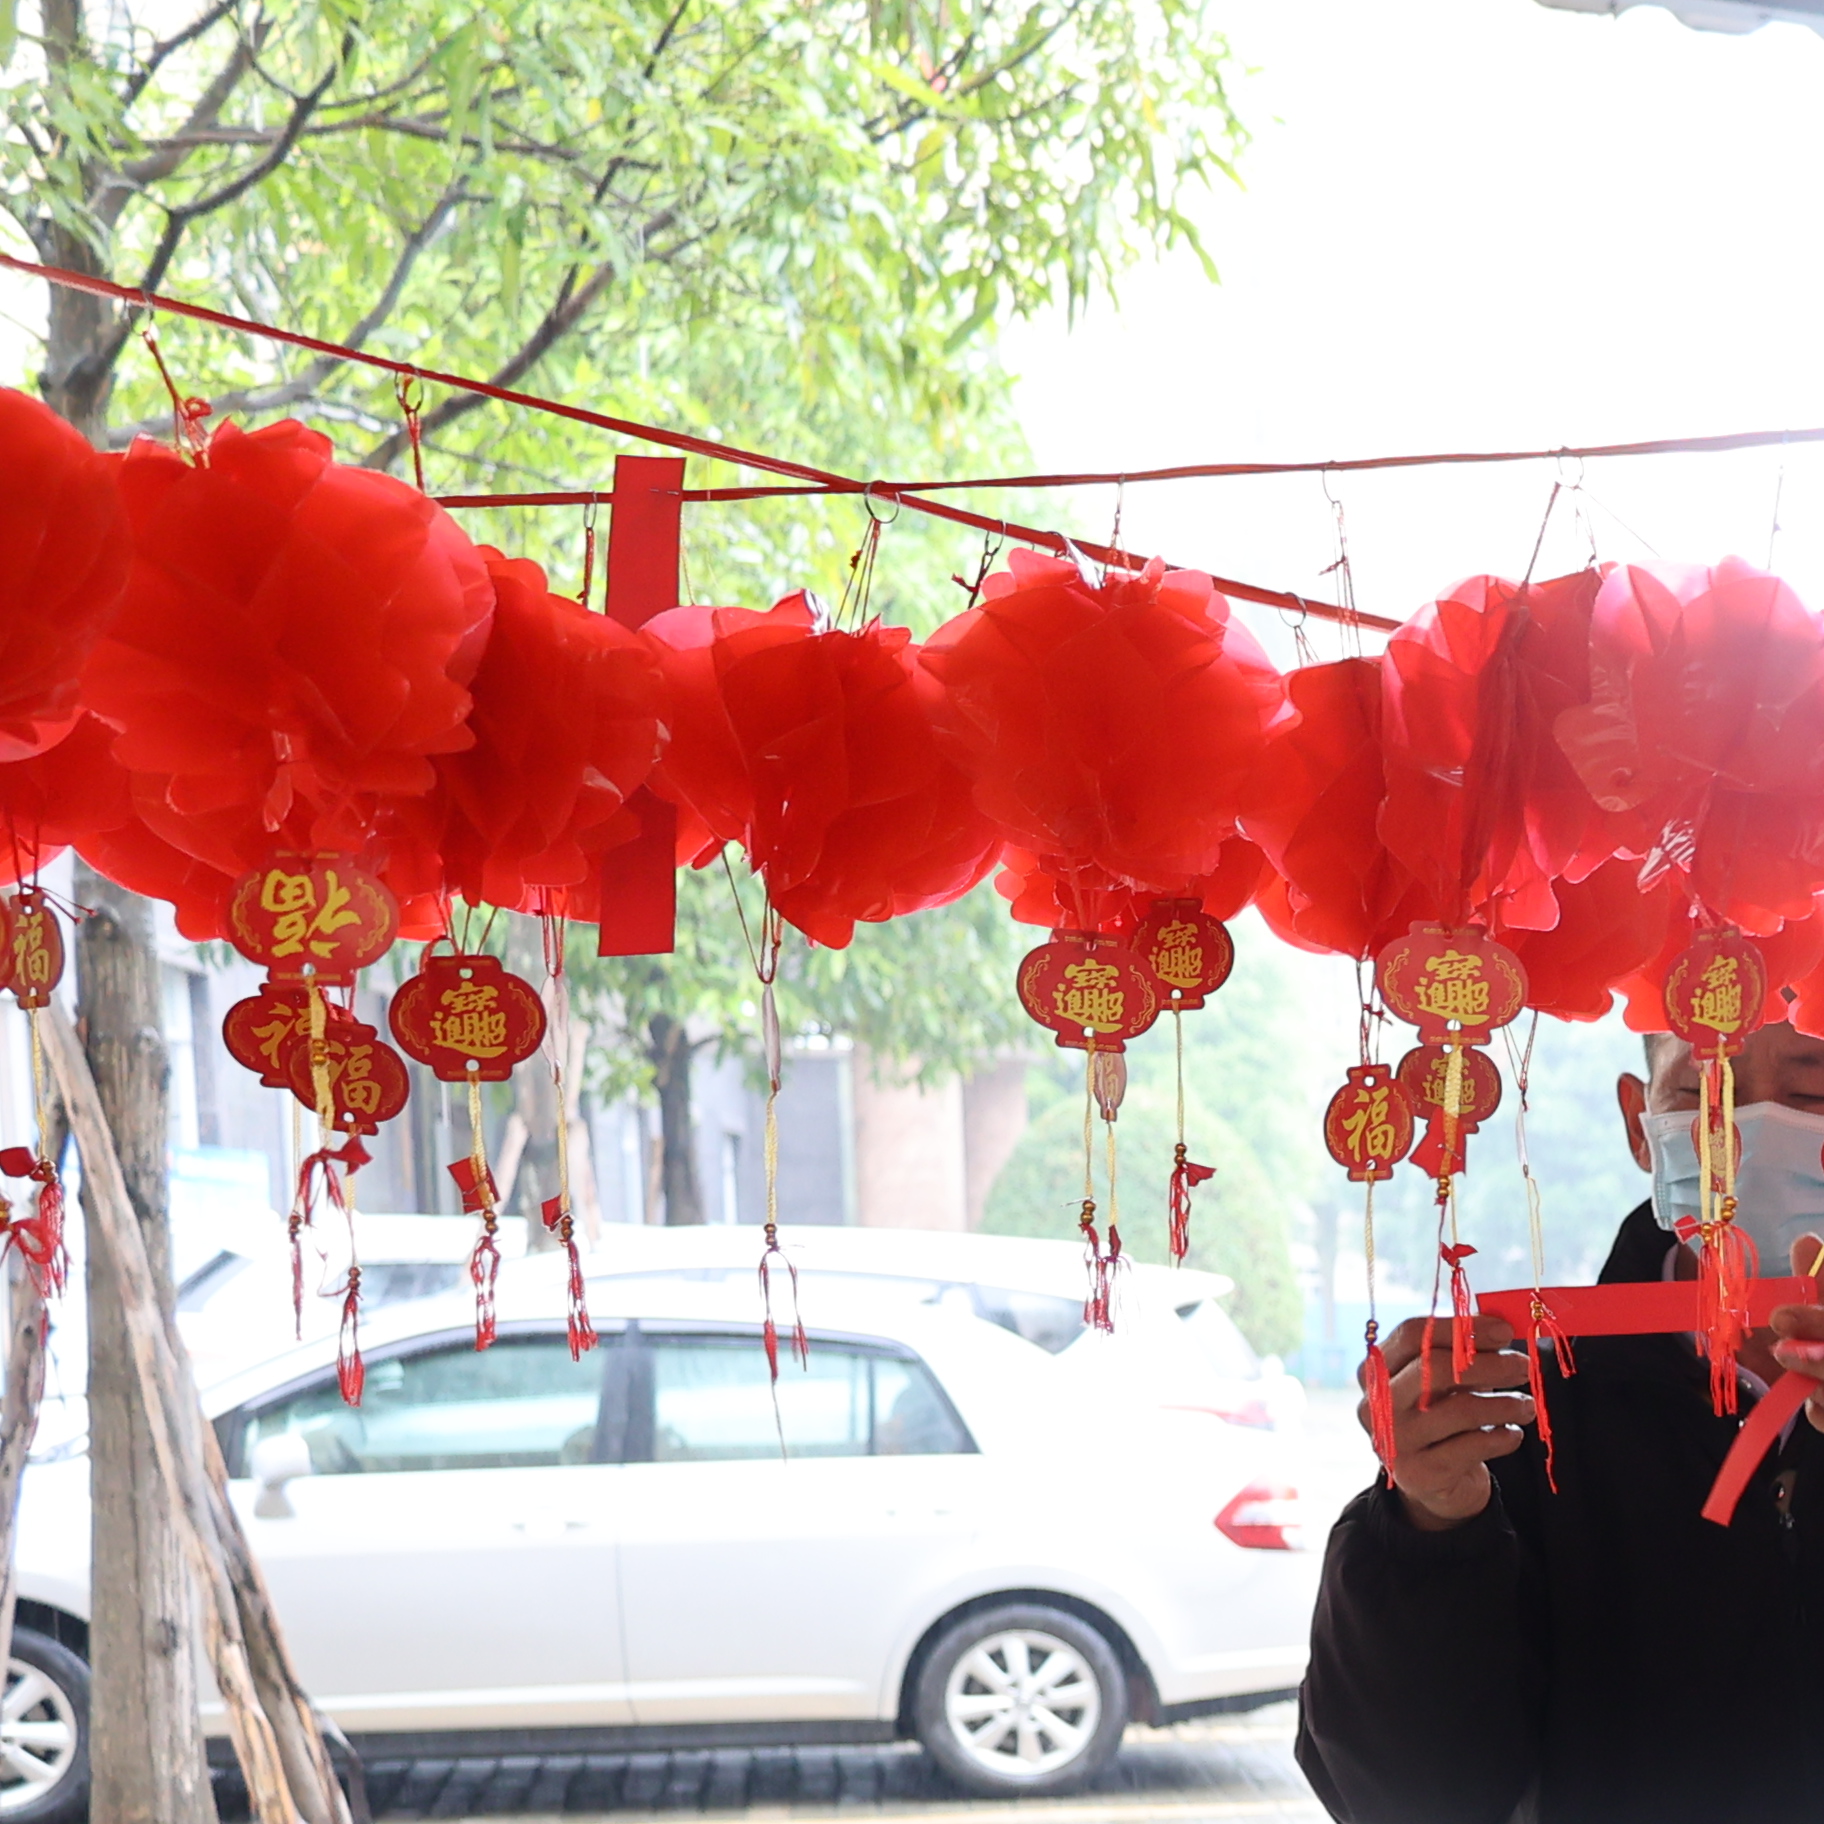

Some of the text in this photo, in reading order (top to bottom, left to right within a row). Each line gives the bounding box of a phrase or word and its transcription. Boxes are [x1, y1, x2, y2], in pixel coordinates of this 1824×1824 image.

[13, 911, 49, 987] 福
[261, 869, 362, 959] 福
[322, 1045, 382, 1114] 福
[1341, 1086, 1396, 1163] 福
